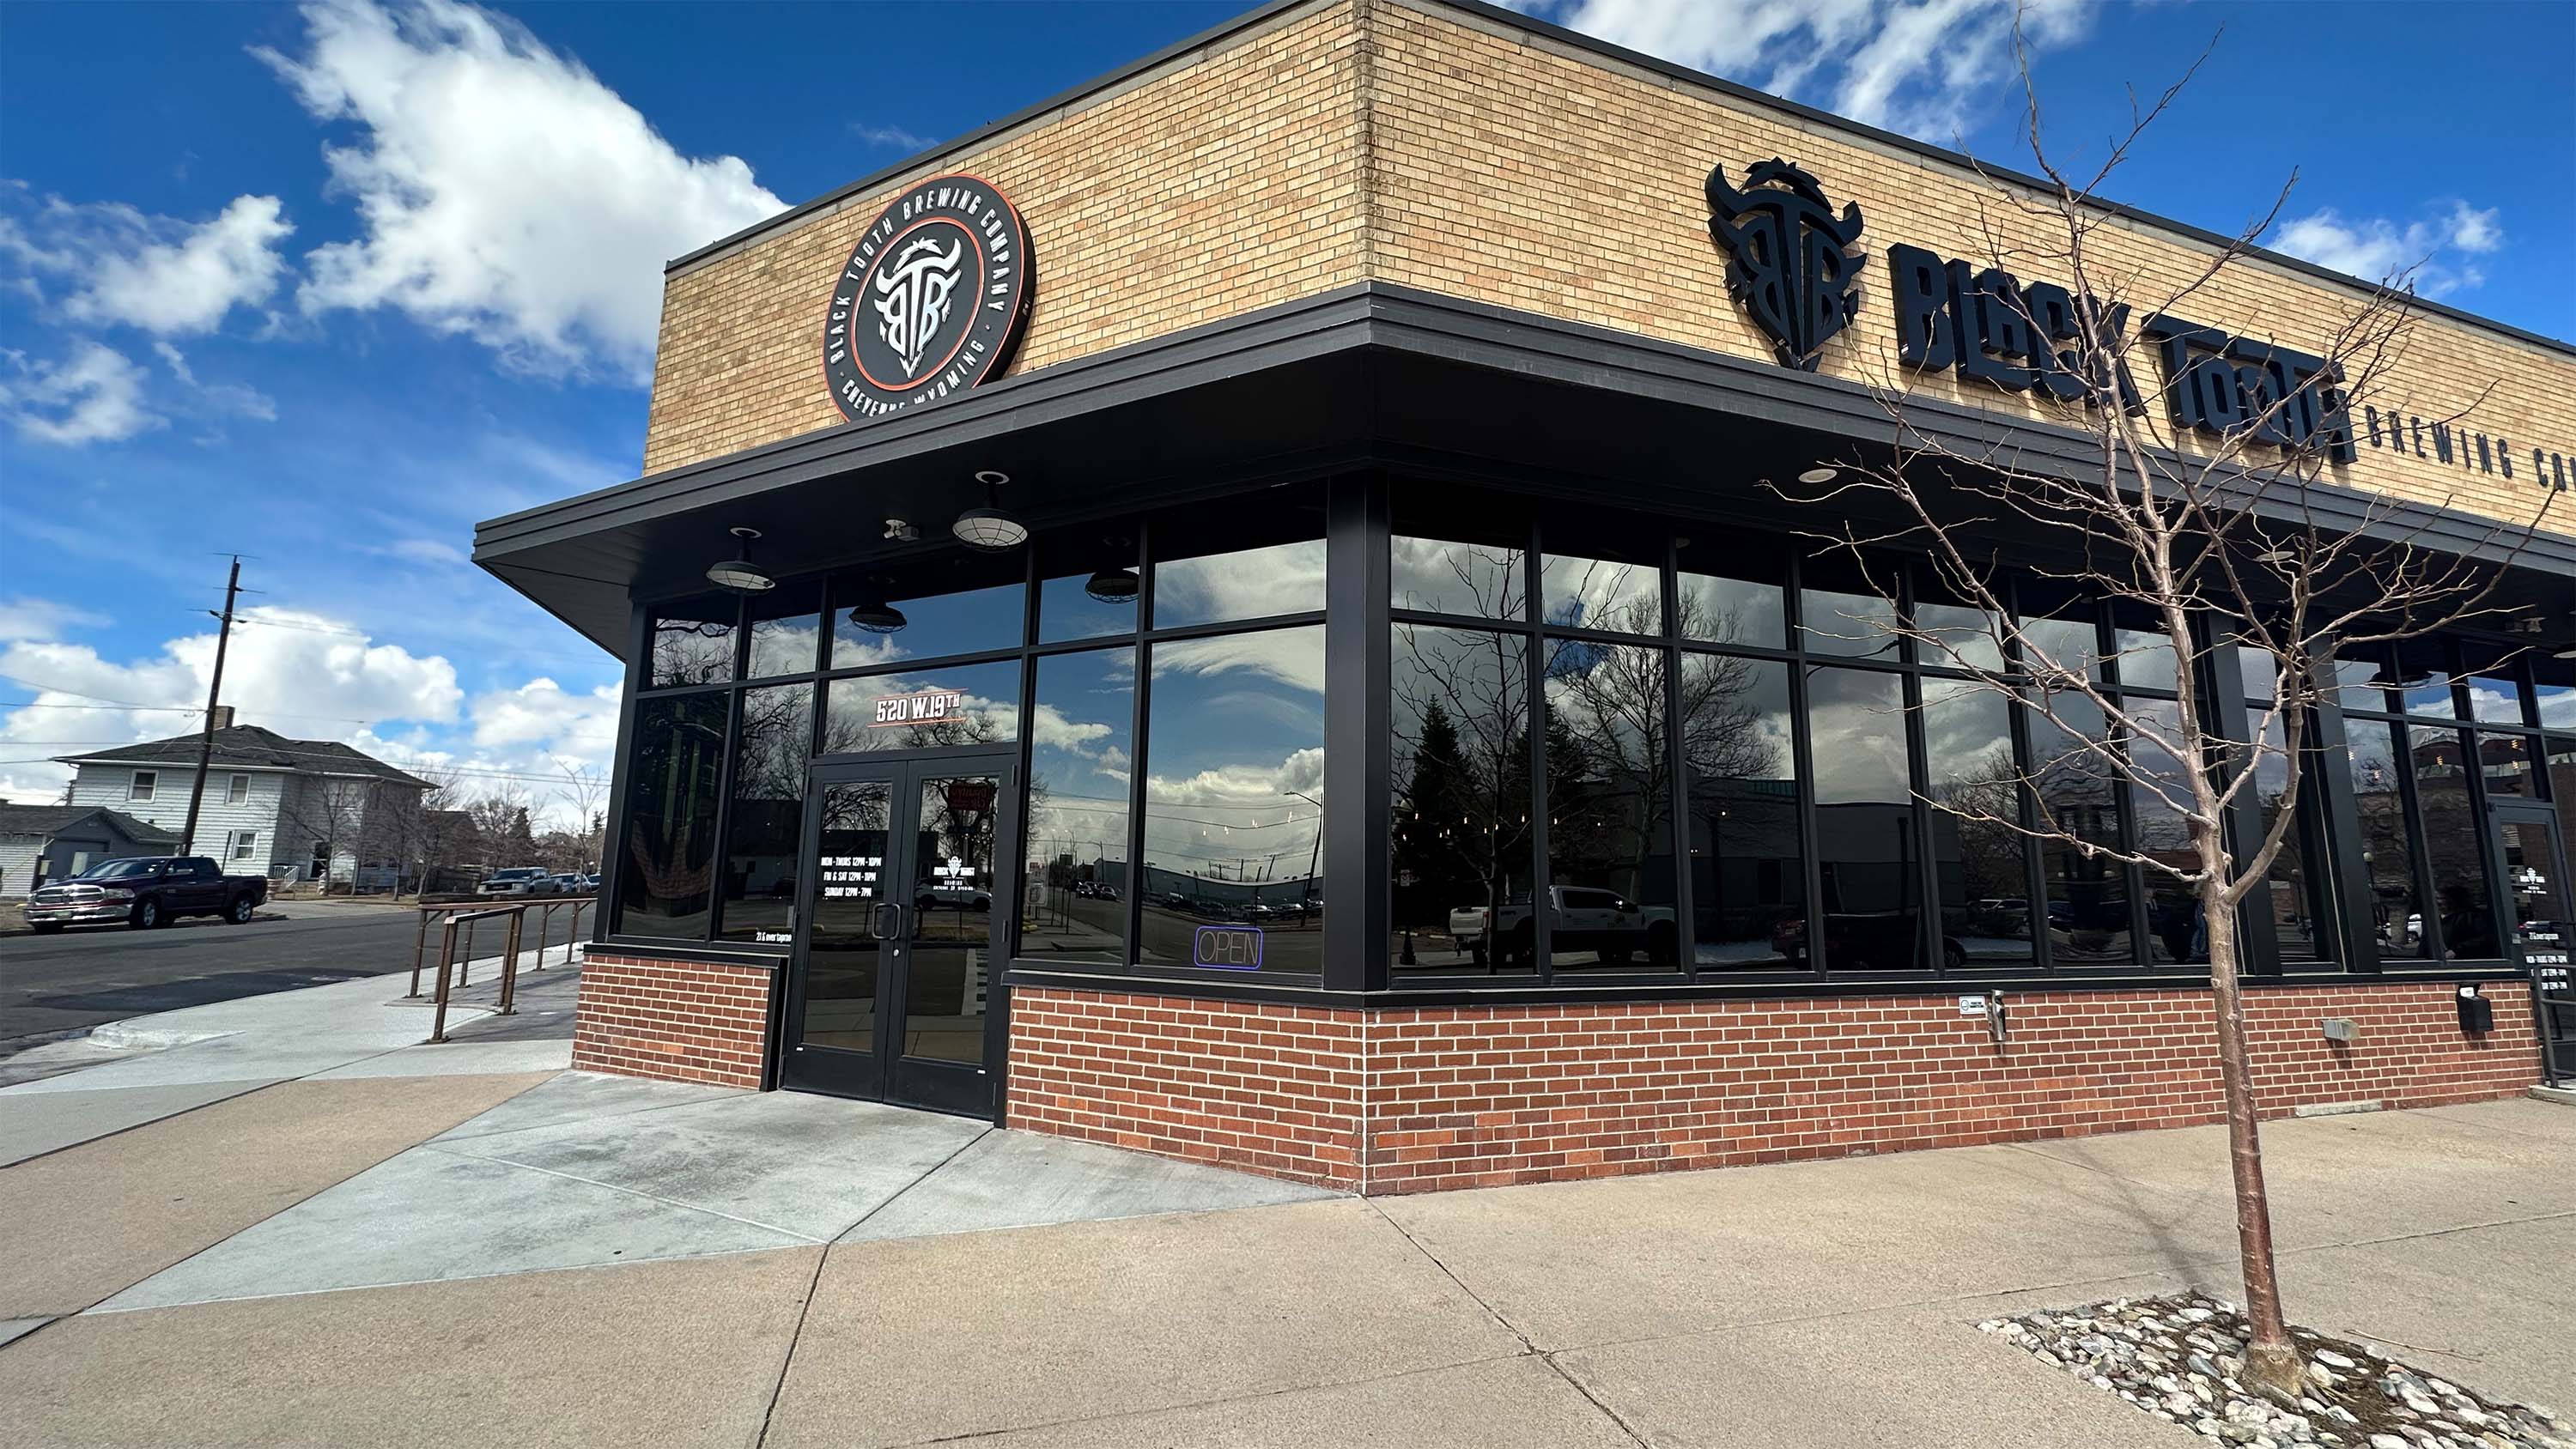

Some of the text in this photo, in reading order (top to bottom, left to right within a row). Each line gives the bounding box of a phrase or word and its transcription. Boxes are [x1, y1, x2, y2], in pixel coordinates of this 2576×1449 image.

[829, 187, 1010, 364] BLACK TOOTH BREWING COMPANY
[1886, 242, 2148, 418] BLACK
[2141, 311, 2358, 464] TOOTH
[2365, 404, 2513, 479] BREWING
[876, 698, 908, 722] 520
[1199, 931, 1259, 963] OPEN
